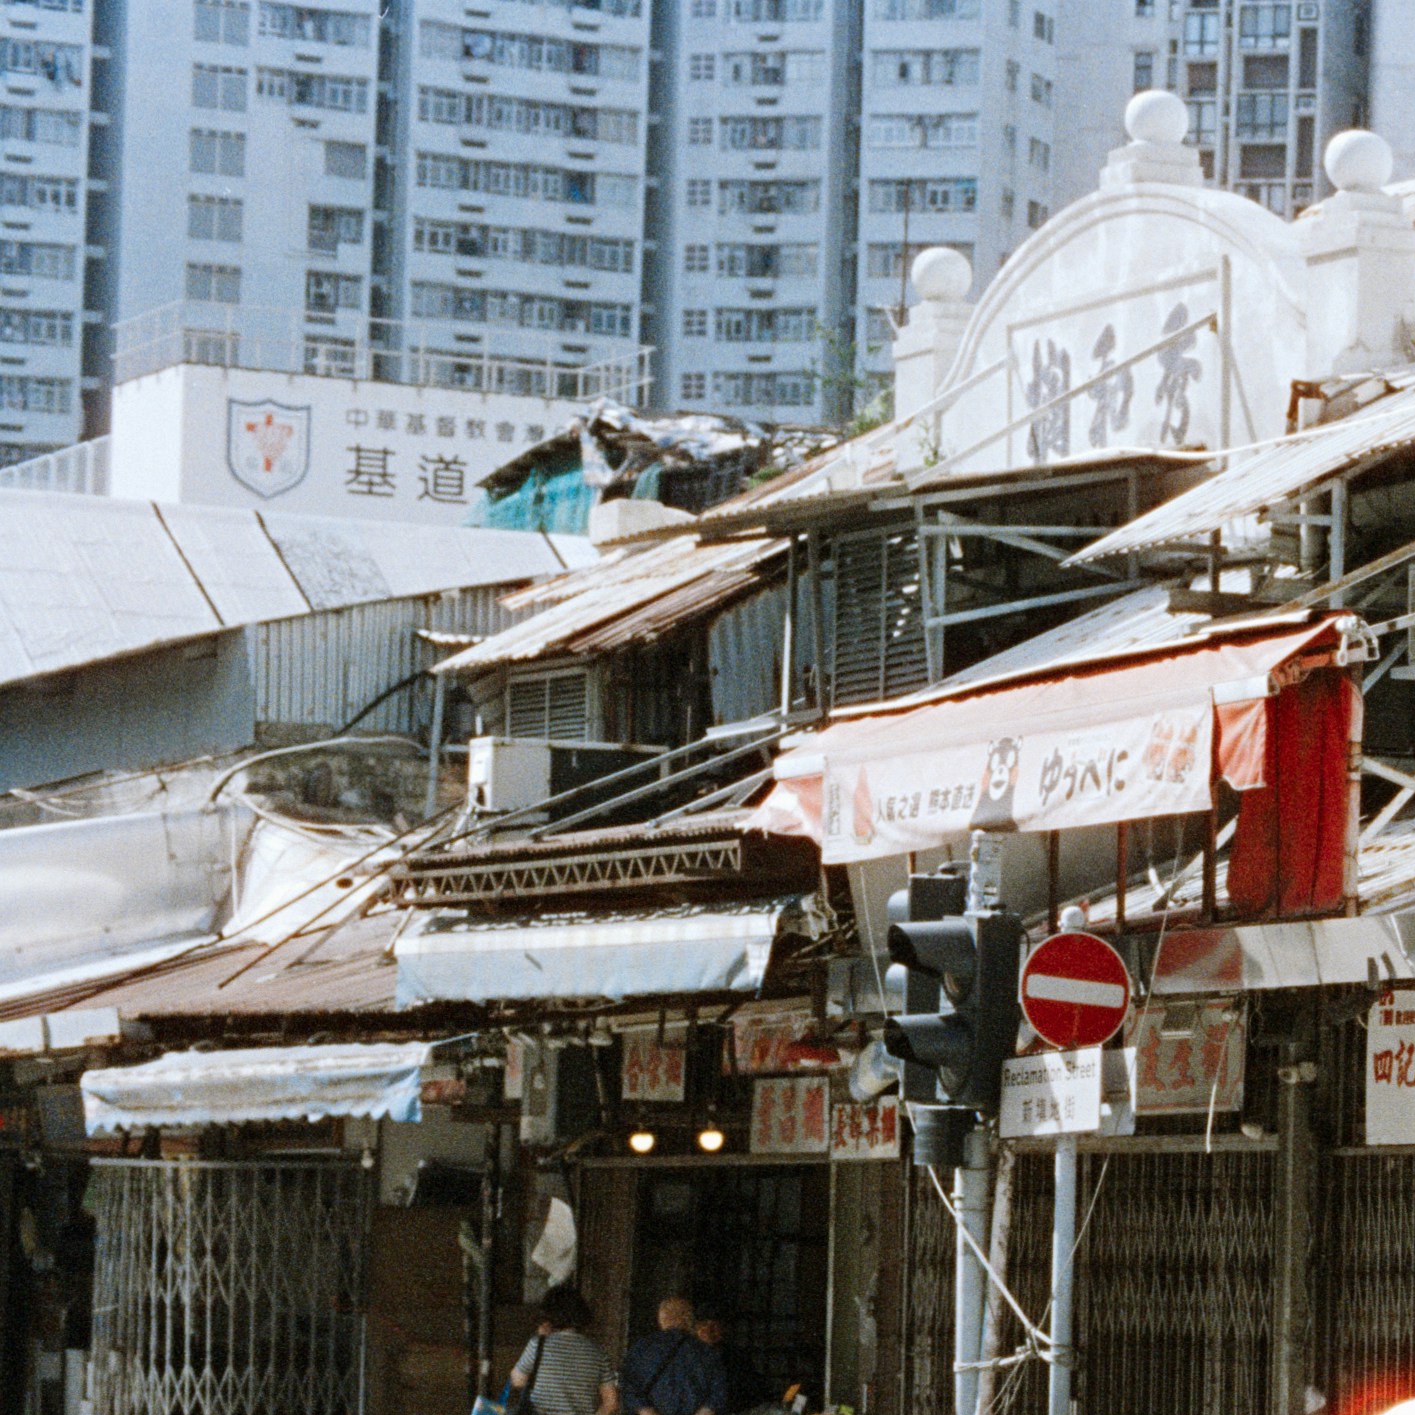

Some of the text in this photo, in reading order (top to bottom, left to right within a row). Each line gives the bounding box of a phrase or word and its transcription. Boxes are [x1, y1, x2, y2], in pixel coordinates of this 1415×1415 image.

[345, 443, 468, 504] 基道
[1003, 1059, 1095, 1087] Reclamation Street
